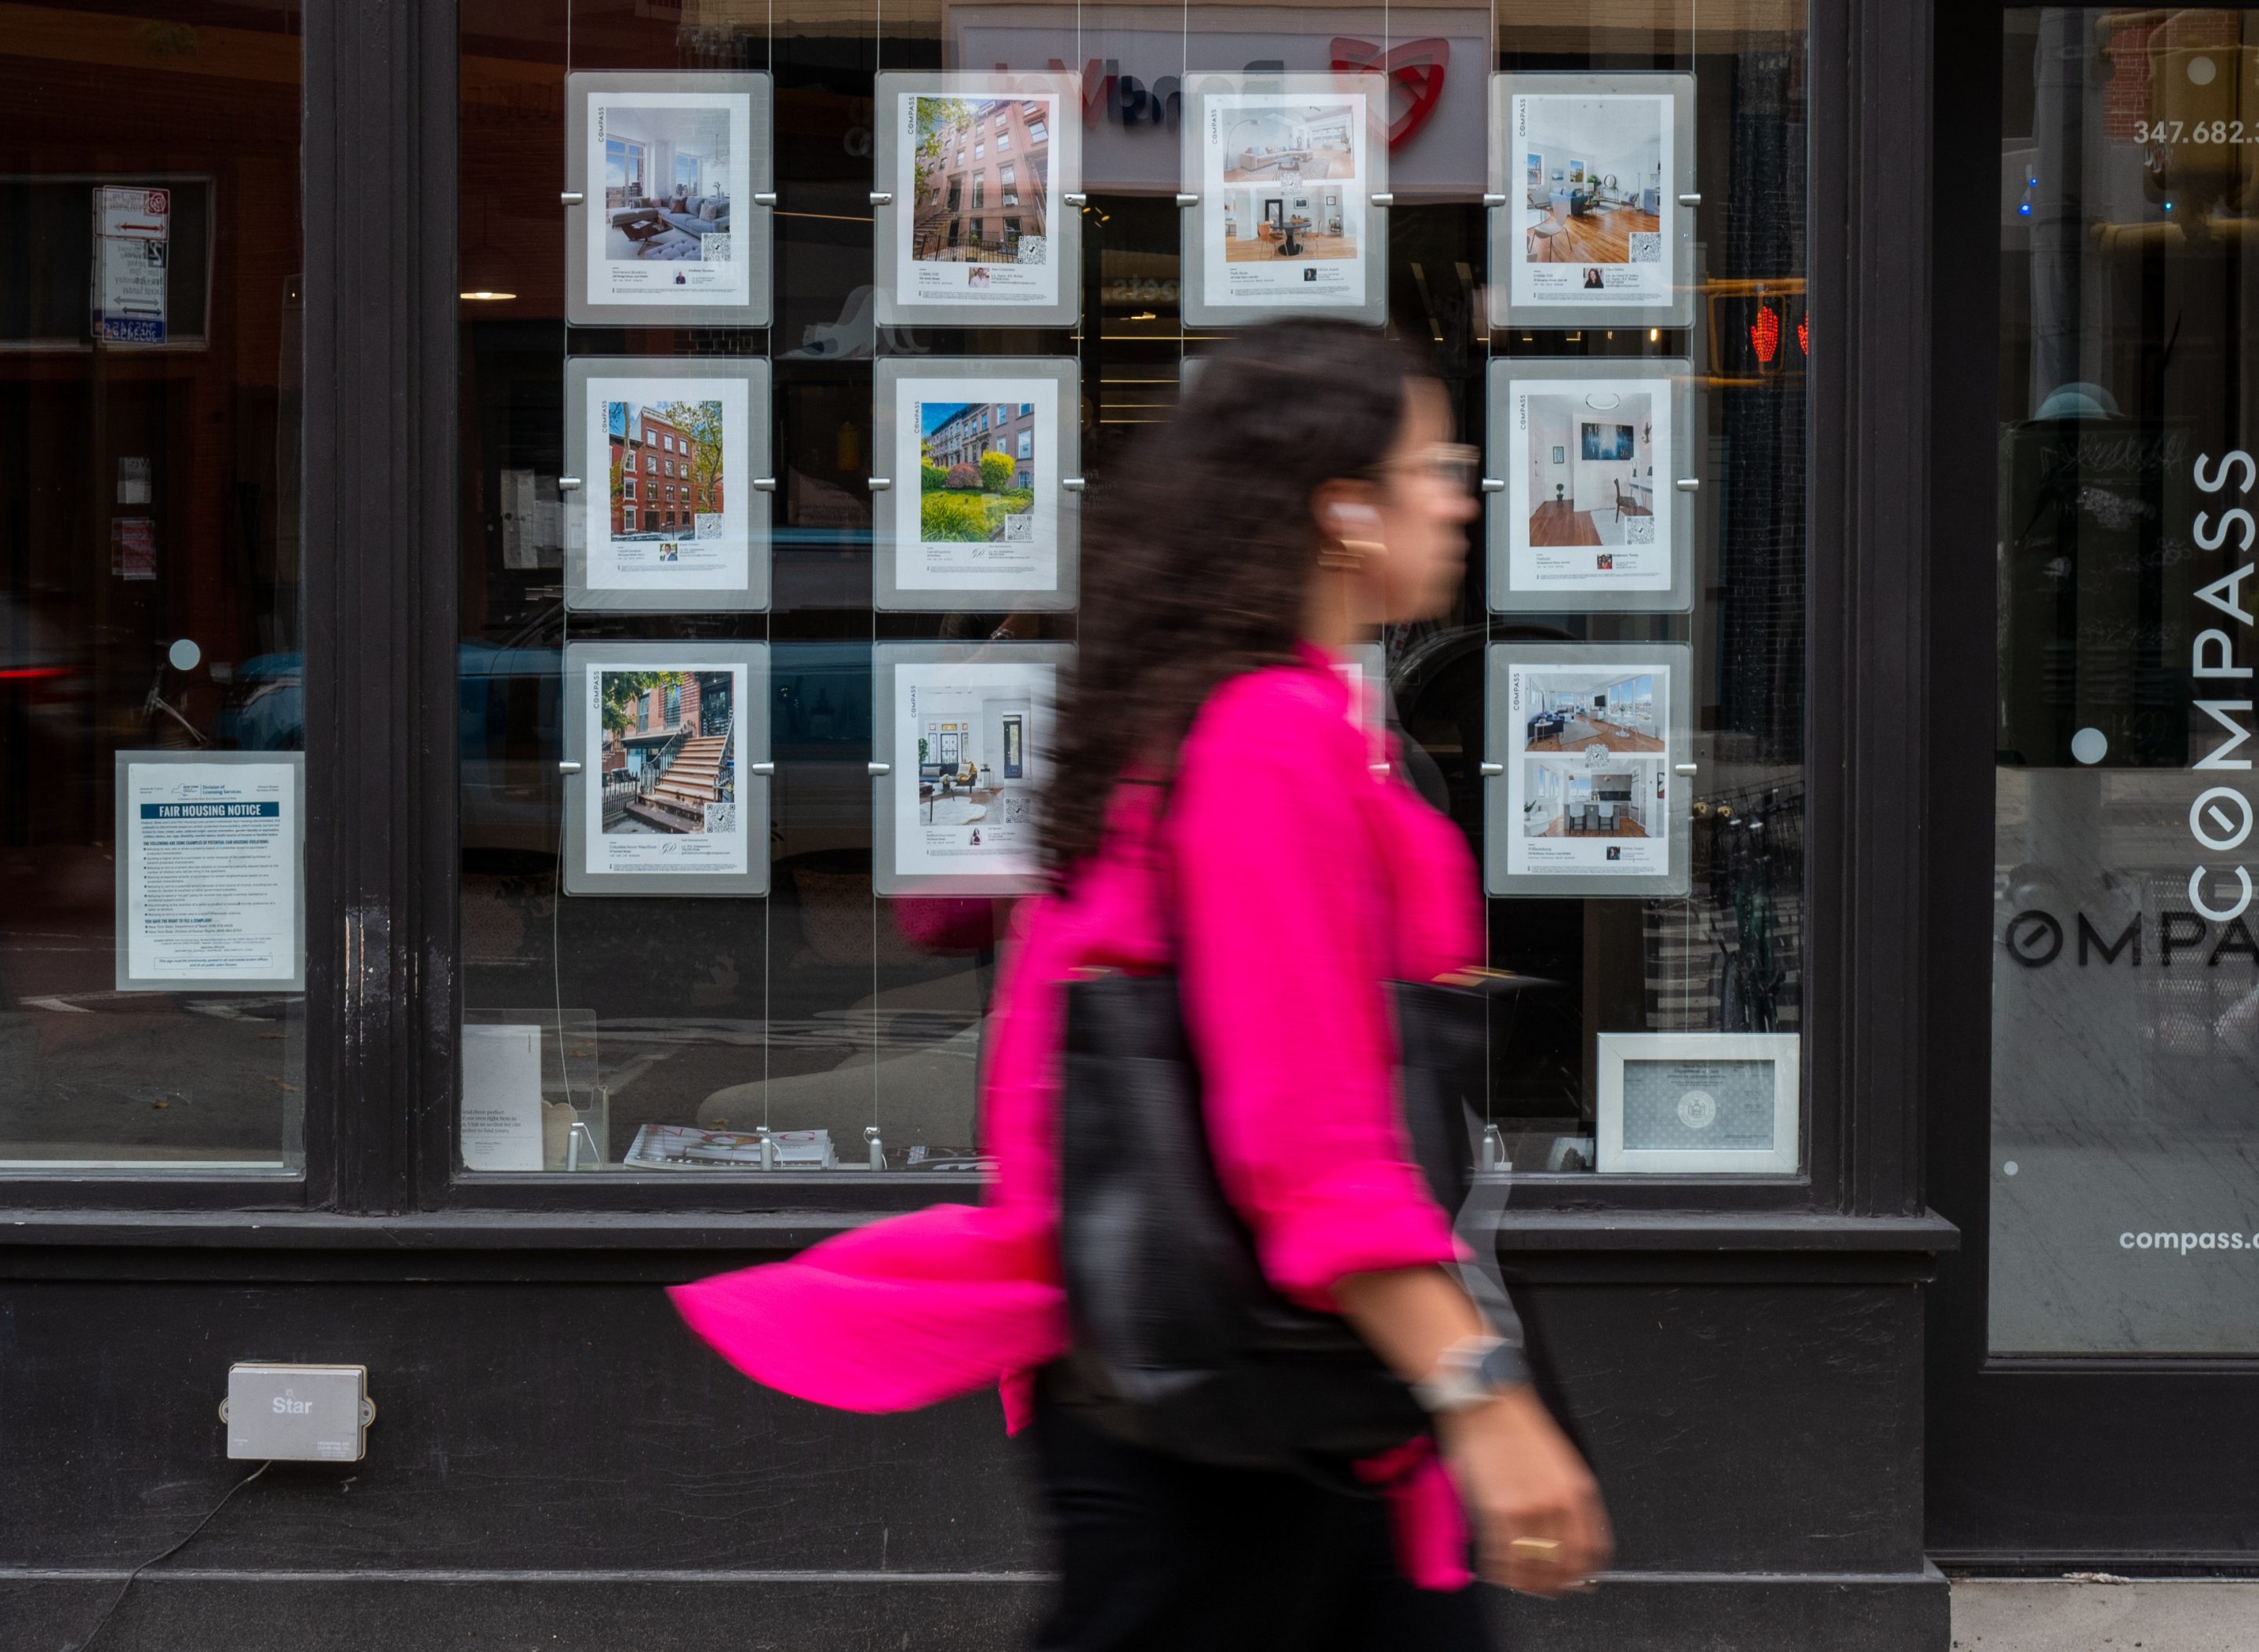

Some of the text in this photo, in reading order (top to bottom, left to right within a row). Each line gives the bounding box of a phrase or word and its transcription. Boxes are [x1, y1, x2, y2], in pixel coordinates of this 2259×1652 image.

[2188, 450, 2256, 922] COMPASS
[159, 804, 261, 817] FAIR HOUSING NOTICE
[272, 1396, 313, 1414] Star
